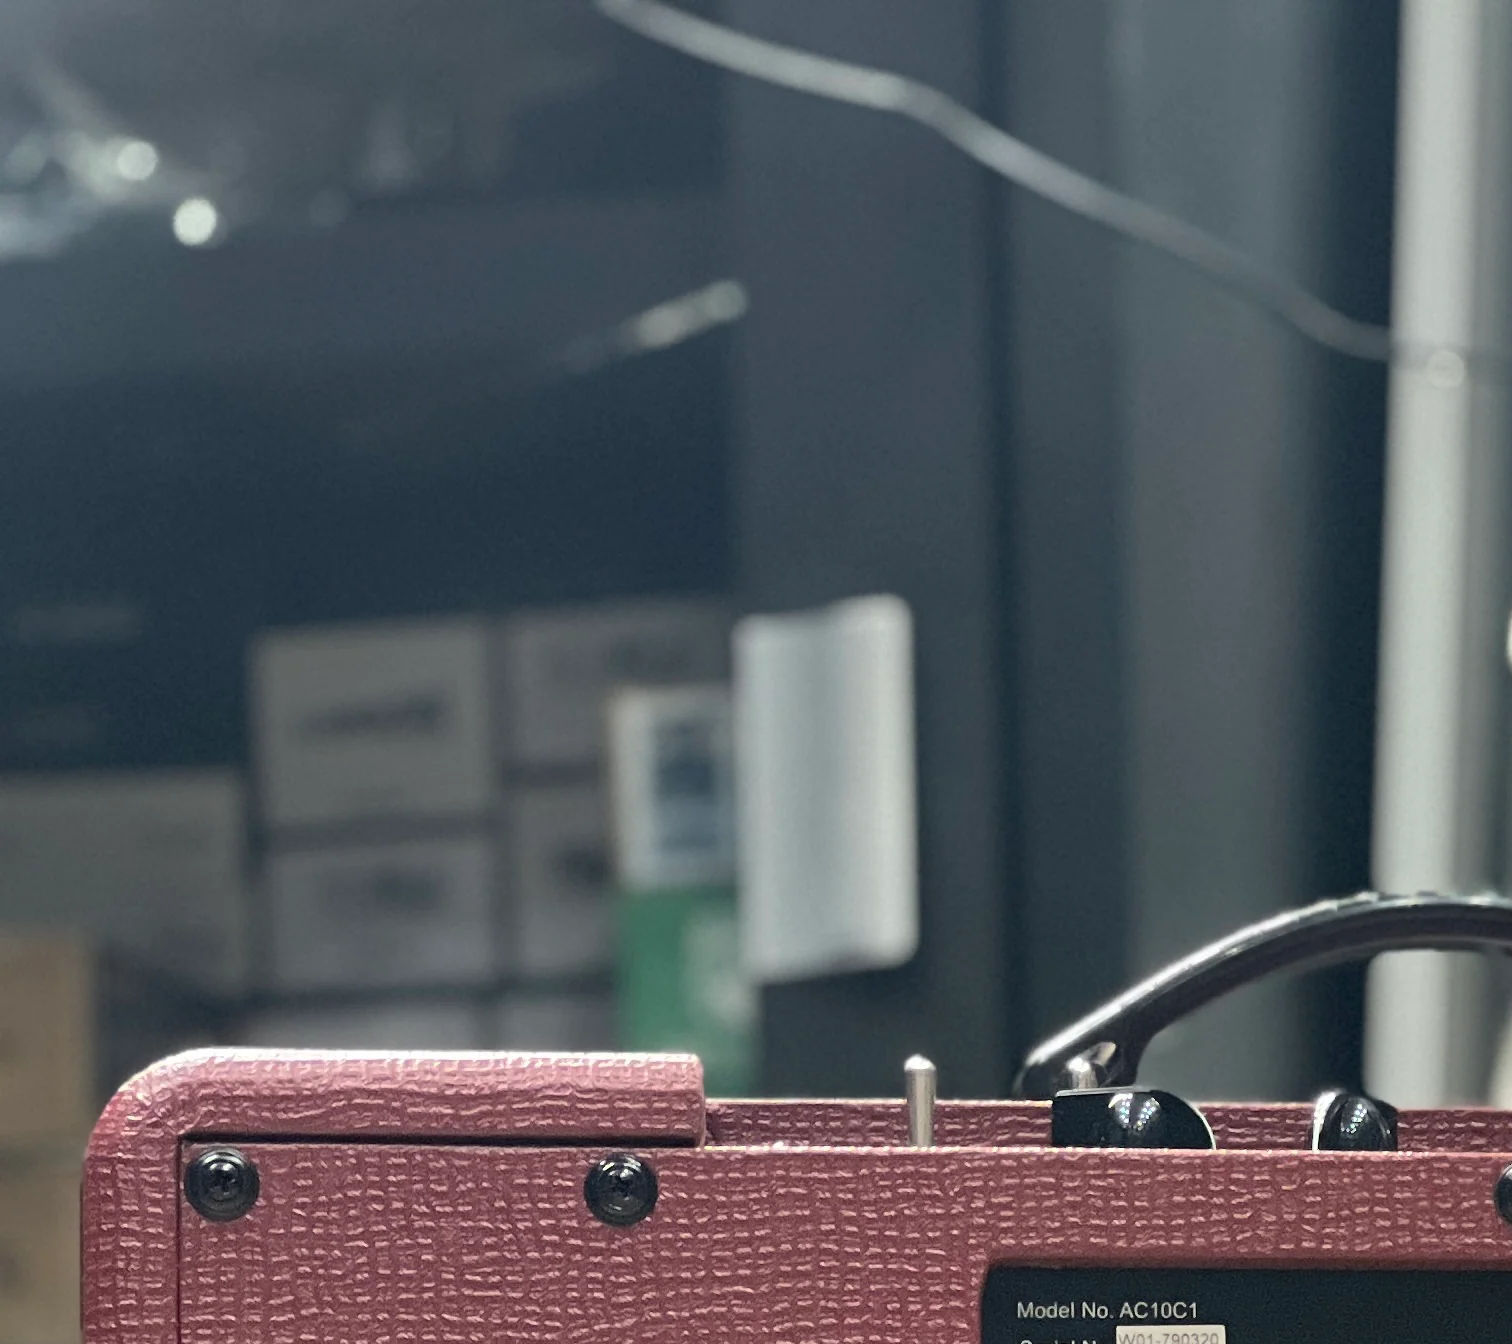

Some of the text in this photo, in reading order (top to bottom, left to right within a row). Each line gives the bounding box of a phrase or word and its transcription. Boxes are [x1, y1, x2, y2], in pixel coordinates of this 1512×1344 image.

[1017, 1302, 1198, 1319] Model No. AC10C1
